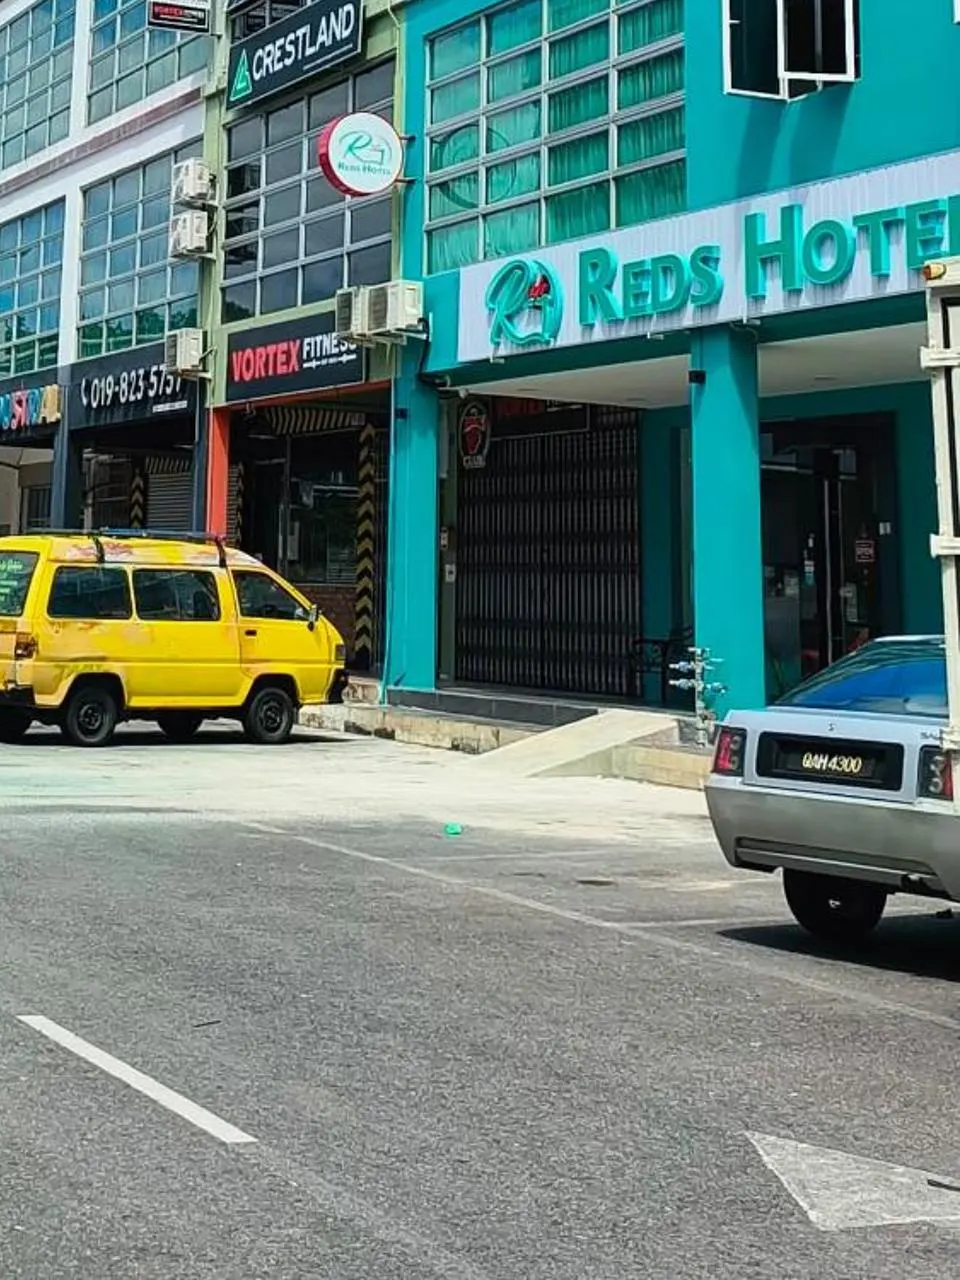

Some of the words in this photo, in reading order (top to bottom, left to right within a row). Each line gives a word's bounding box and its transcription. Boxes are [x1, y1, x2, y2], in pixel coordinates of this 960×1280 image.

[253, 3, 355, 81] CRESTLAND
[578, 245, 724, 325] REDS
[232, 339, 300, 382] VORTEX
[90, 367, 145, 409] 019-823
[802, 751, 829, 771] QAH
[828, 754, 862, 773] 4300
